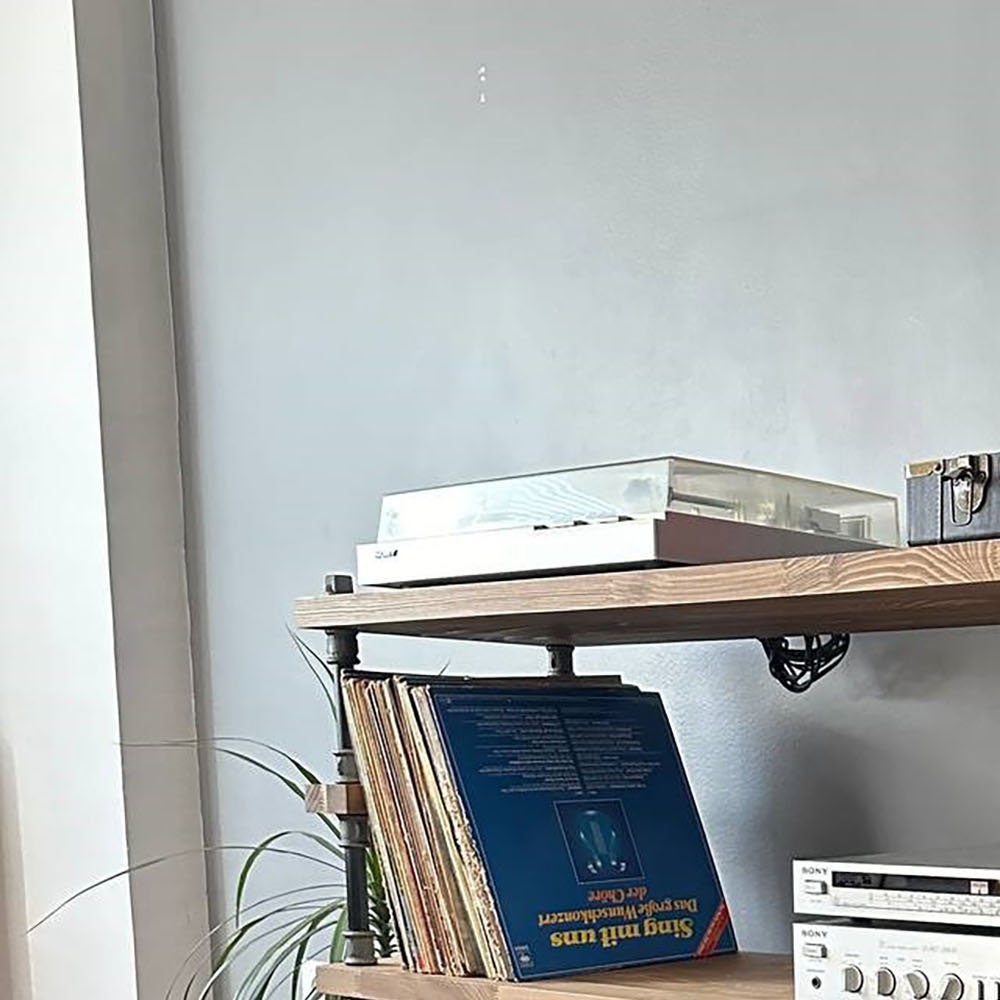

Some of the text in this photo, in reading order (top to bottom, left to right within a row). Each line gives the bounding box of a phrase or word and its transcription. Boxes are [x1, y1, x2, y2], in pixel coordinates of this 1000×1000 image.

[802, 866, 828, 876] SONY
[588, 886, 648, 903] der Chöre
[538, 898, 699, 926] Das große Wunschkonzert
[550, 917, 694, 948] Sing mit uns
[802, 929, 828, 939] SONY
